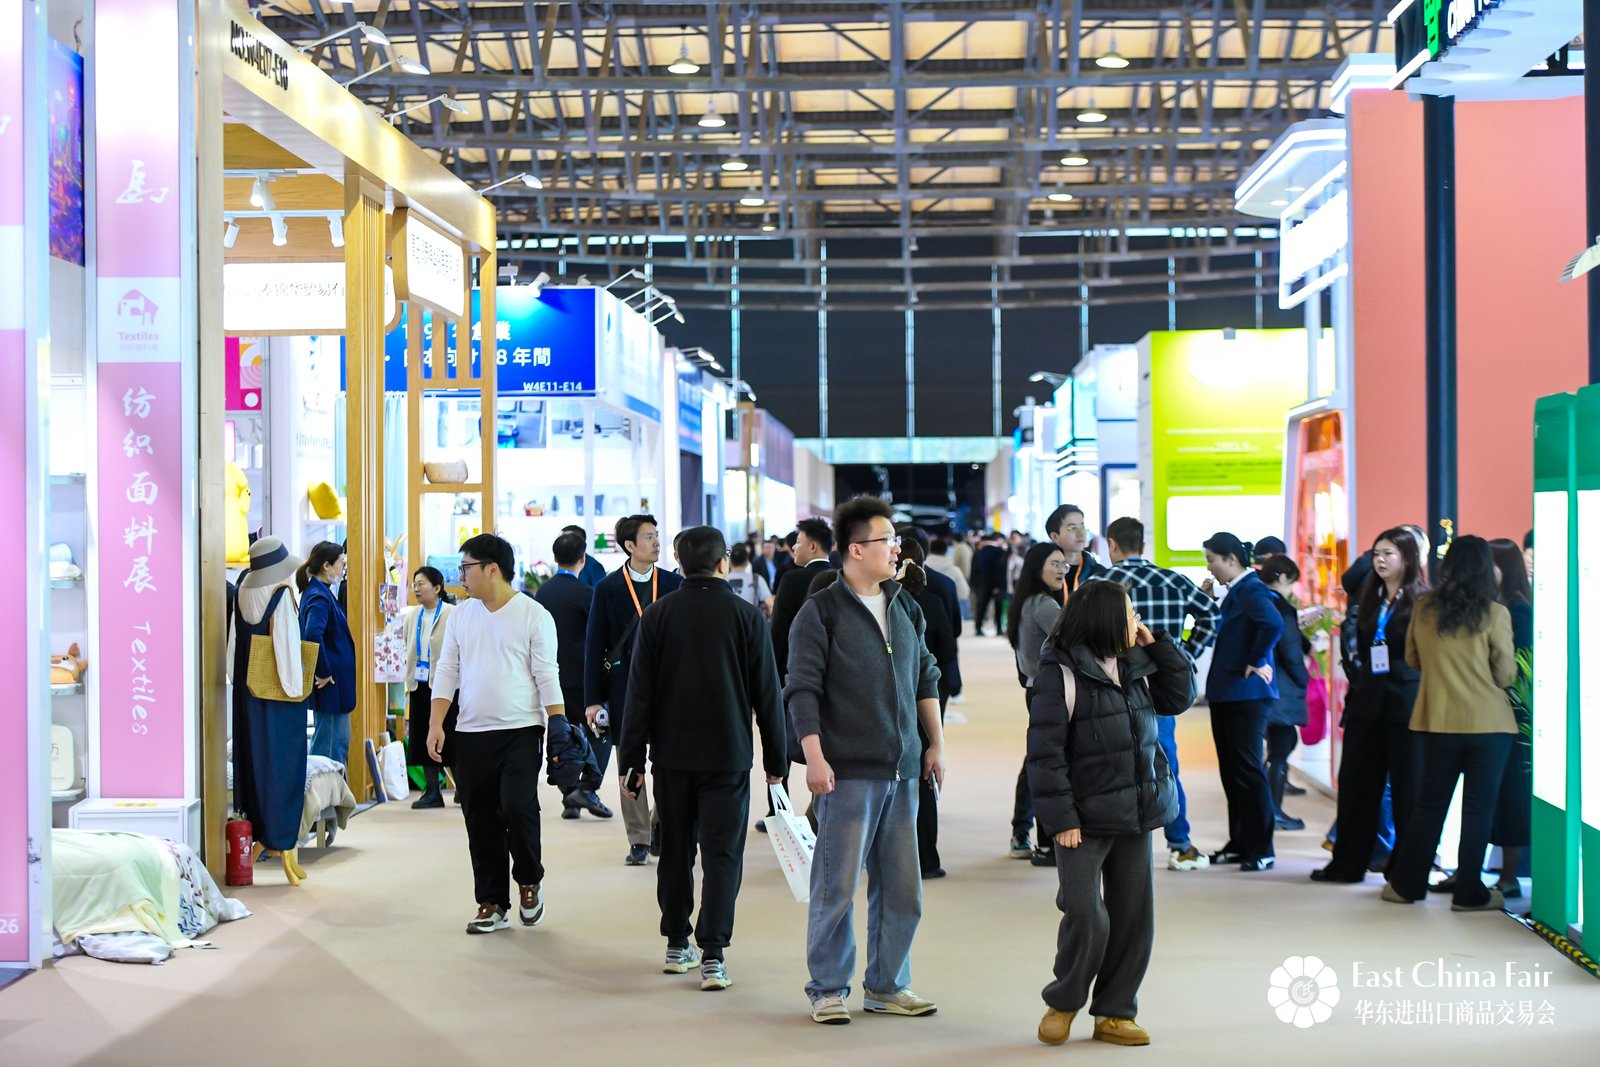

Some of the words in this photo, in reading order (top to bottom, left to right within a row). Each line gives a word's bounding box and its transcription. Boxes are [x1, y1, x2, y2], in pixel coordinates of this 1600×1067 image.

[118, 332, 160, 342] Textiles
[523, 381, 582, 392] W4E11-E14
[123, 387, 159, 593] 纺织面料展
[131, 621, 156, 735] Textiles
